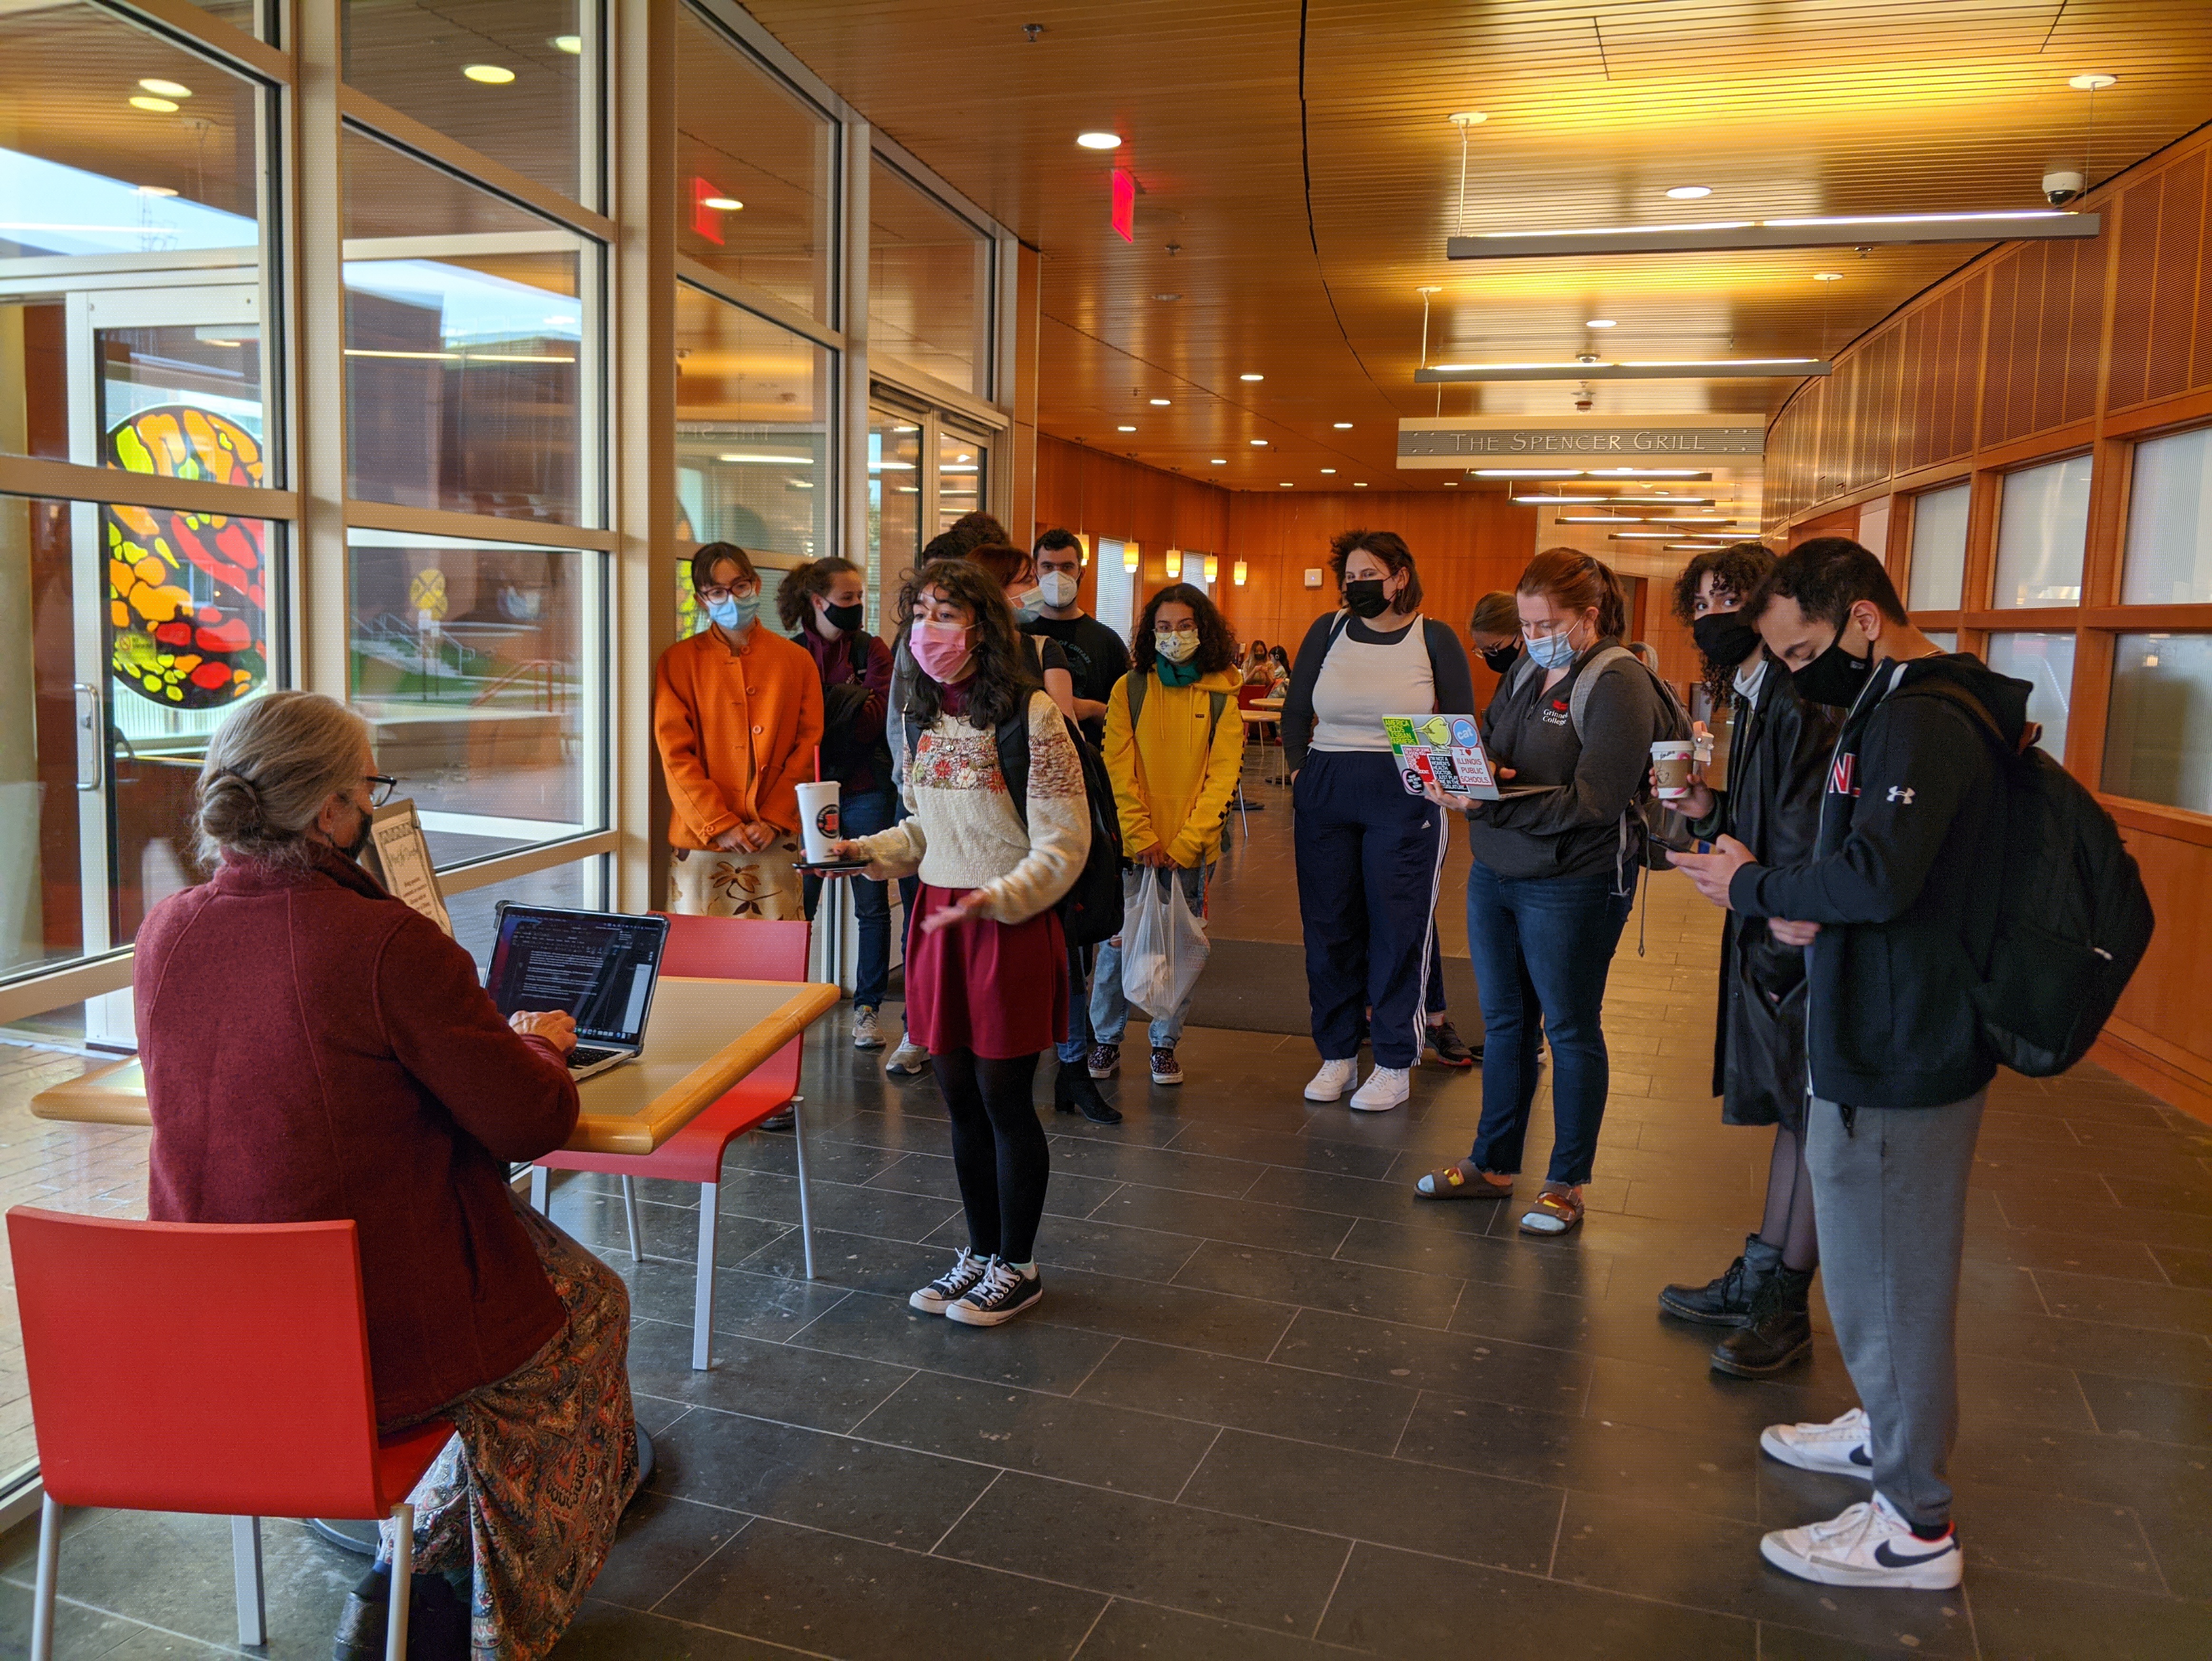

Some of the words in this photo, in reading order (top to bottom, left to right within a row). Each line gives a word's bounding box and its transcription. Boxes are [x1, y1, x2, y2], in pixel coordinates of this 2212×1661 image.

[1449, 433, 1500, 451] THE
[1510, 432, 1623, 451] SPENCER
[1634, 431, 1708, 451] GRILL
[1543, 715, 1567, 726] College
[1457, 727, 1473, 740] cat
[1460, 775, 1491, 783] SCHOOLS.
